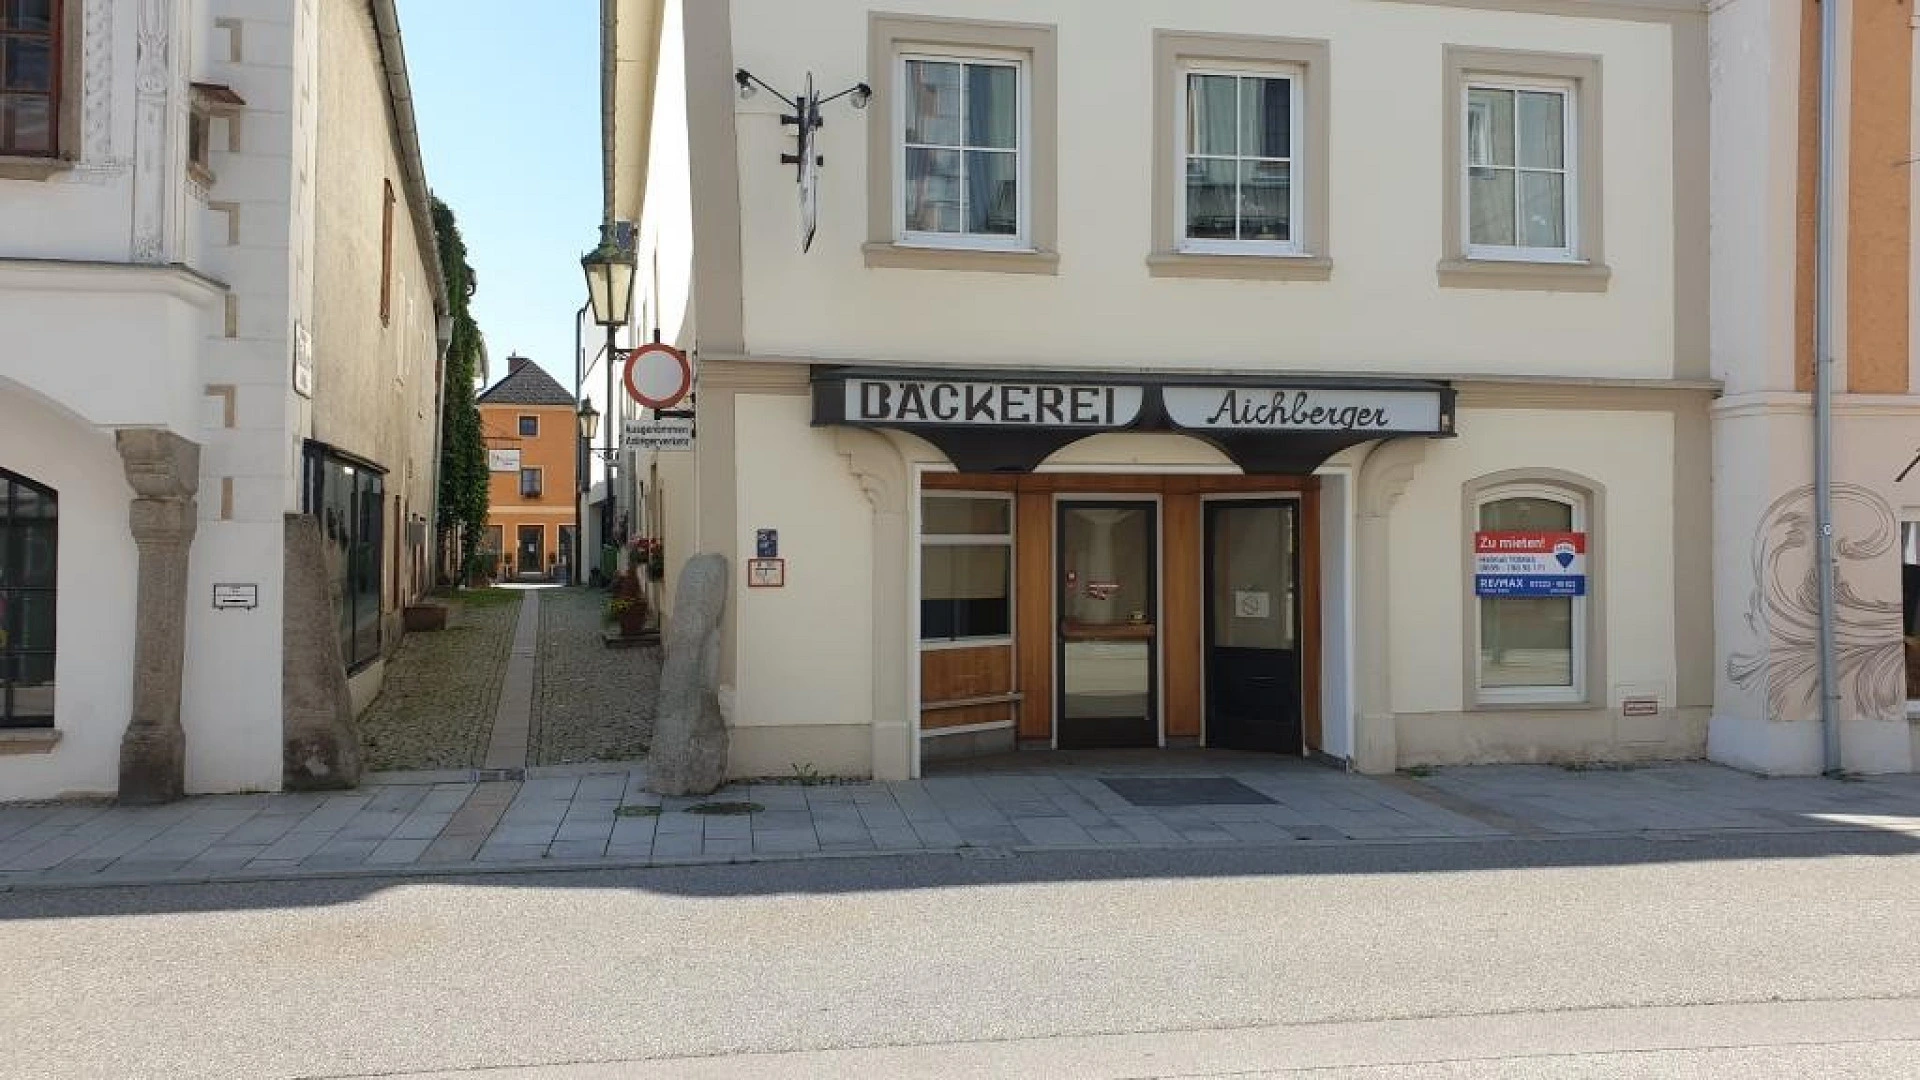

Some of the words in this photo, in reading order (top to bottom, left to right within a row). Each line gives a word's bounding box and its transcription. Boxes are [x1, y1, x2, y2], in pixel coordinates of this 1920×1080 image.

[861, 380, 1115, 424] BÄCKEREI
[1206, 389, 1388, 429] Aichberger
[1480, 535, 1497, 549] Zu
[1499, 535, 1546, 549] mieten!
[1479, 578, 1524, 588] RE/MAX
